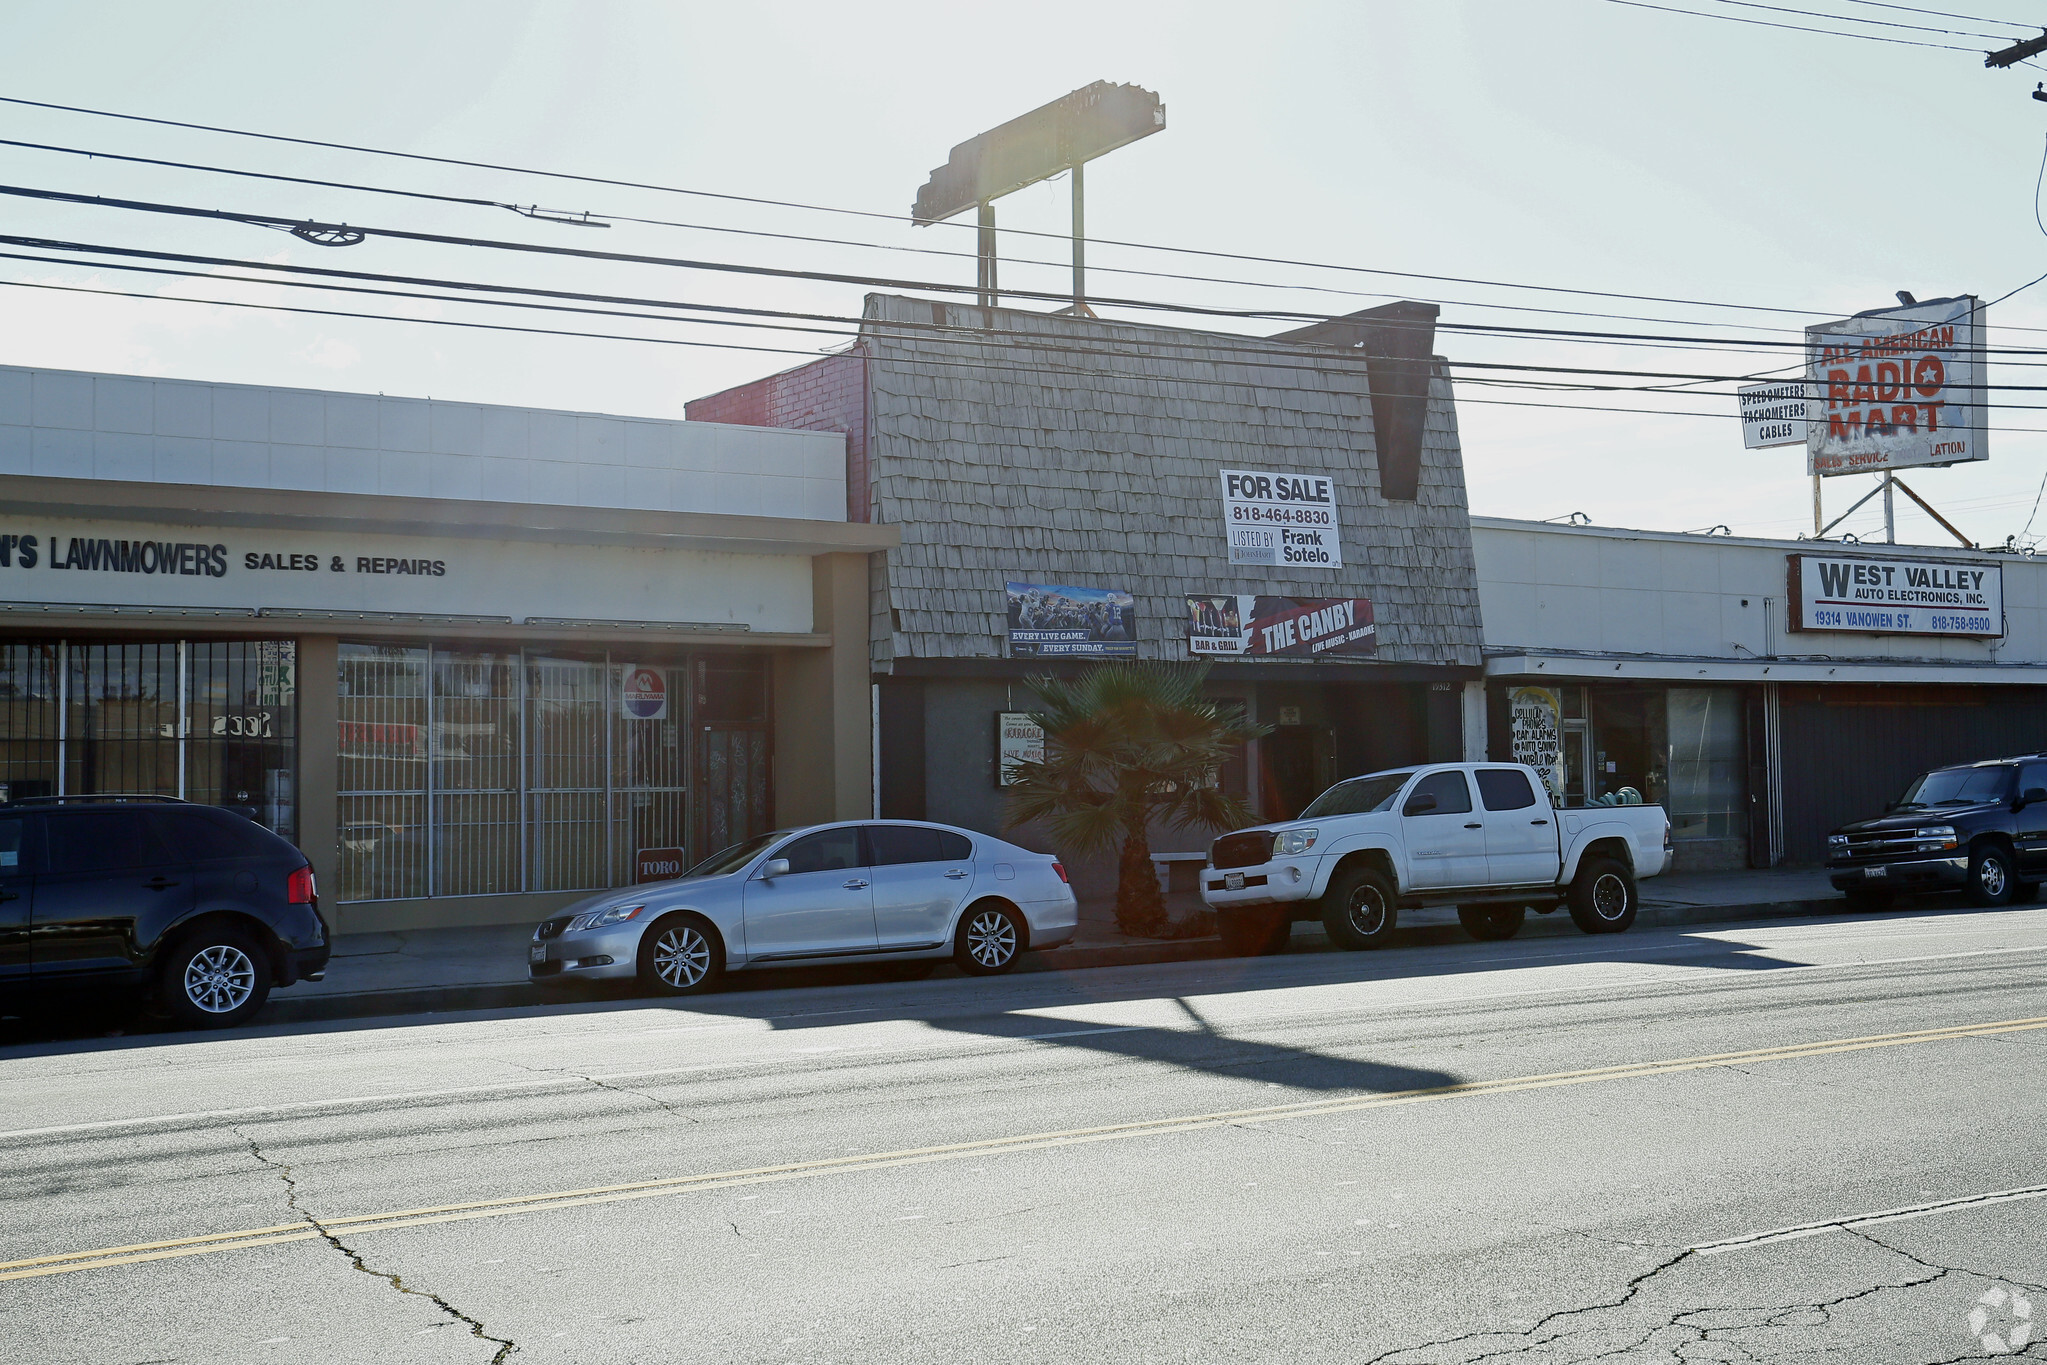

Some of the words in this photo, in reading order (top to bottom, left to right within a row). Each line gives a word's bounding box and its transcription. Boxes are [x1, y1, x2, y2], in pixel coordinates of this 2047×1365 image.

[1820, 342, 1855, 367] ALL
[1861, 326, 1954, 361] AMERICAN
[1828, 355, 1945, 410] RADIO
[1742, 384, 1805, 406] SPEEDOMETERS
[1743, 402, 1805, 424] TACHOMETERS
[1829, 399, 1944, 439] MART
[1759, 423, 1793, 440] CABLES
[1815, 456, 1842, 469] SALES
[1849, 452, 1888, 466] SERVICE
[1226, 474, 1273, 500] FOR
[1275, 476, 1330, 502] SALE
[1233, 506, 1330, 525] 818-464-8830
[1232, 530, 1261, 547] LISTED
[1263, 532, 1275, 547] BY
[1281, 529, 1323, 546] Frank
[50, 536, 228, 578] LAWNMOWERS
[244, 552, 319, 572] SALES
[329, 555, 346, 574] &
[356, 556, 447, 577] REPAIRS
[1283, 546, 1330, 563] Sotelo
[1818, 562, 1896, 598] WEST
[1905, 567, 1985, 590] VALLEY
[1855, 588, 1885, 600] AUTO
[1887, 589, 1963, 605] ELECTRONICS,
[1965, 593, 1986, 604] INC.
[1262, 619, 1297, 654] THE
[1297, 599, 1355, 642] CANBY
[1815, 610, 1842, 626] 19314
[1846, 611, 1893, 628] VANOWEN
[1896, 614, 1912, 628] ST.
[1931, 616, 1990, 631] 818-758-9500
[1012, 632, 1040, 640] EVERY
[1041, 632, 1060, 640] LIVE
[1060, 632, 1086, 640] GAME.
[1312, 641, 1326, 653] LIVE
[1325, 636, 1346, 648] MUSIC
[1348, 624, 1376, 642] KARAOKE
[1043, 644, 1070, 652] EVERY
[1071, 644, 1104, 652] SUNDAY.
[1195, 640, 1210, 650] BAR
[1211, 641, 1217, 650] &
[1218, 640, 1238, 651] GRILL
[1432, 682, 1451, 691] 19312
[1521, 741, 1536, 751] AUTO
[640, 860, 680, 876] TORO
